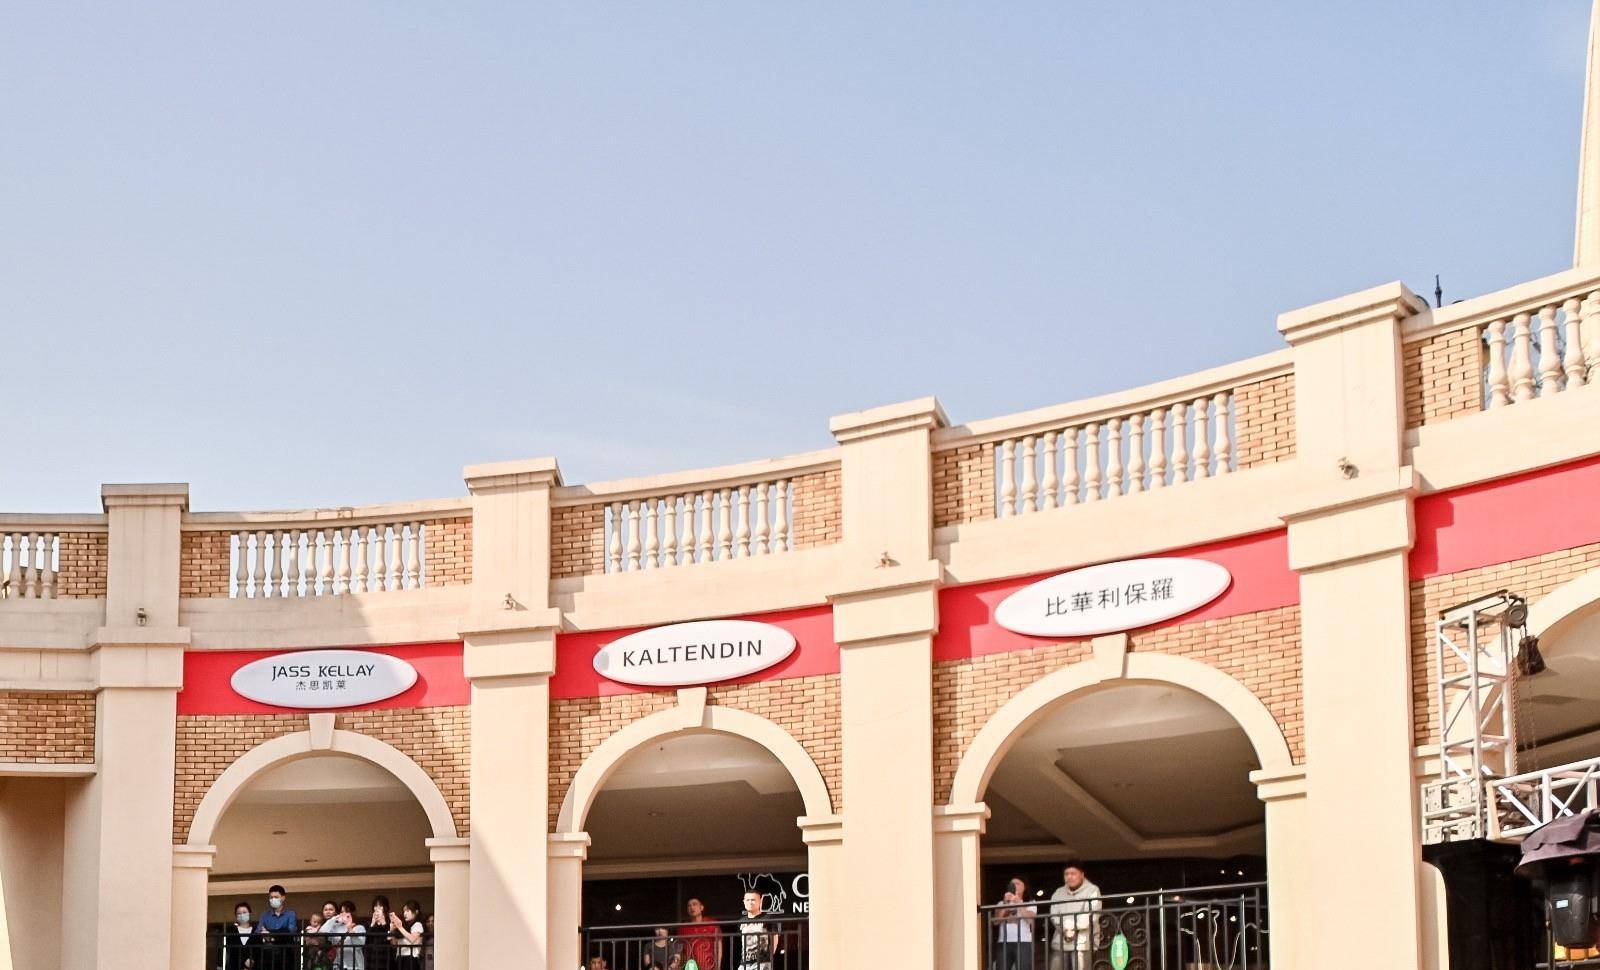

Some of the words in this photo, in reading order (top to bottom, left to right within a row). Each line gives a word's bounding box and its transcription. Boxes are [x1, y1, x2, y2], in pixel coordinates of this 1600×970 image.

[1045, 577, 1174, 617] 比華利保羅
[623, 639, 762, 667] KALTENDIN
[271, 666, 310, 682] JASS
[318, 664, 375, 678] KELLAY
